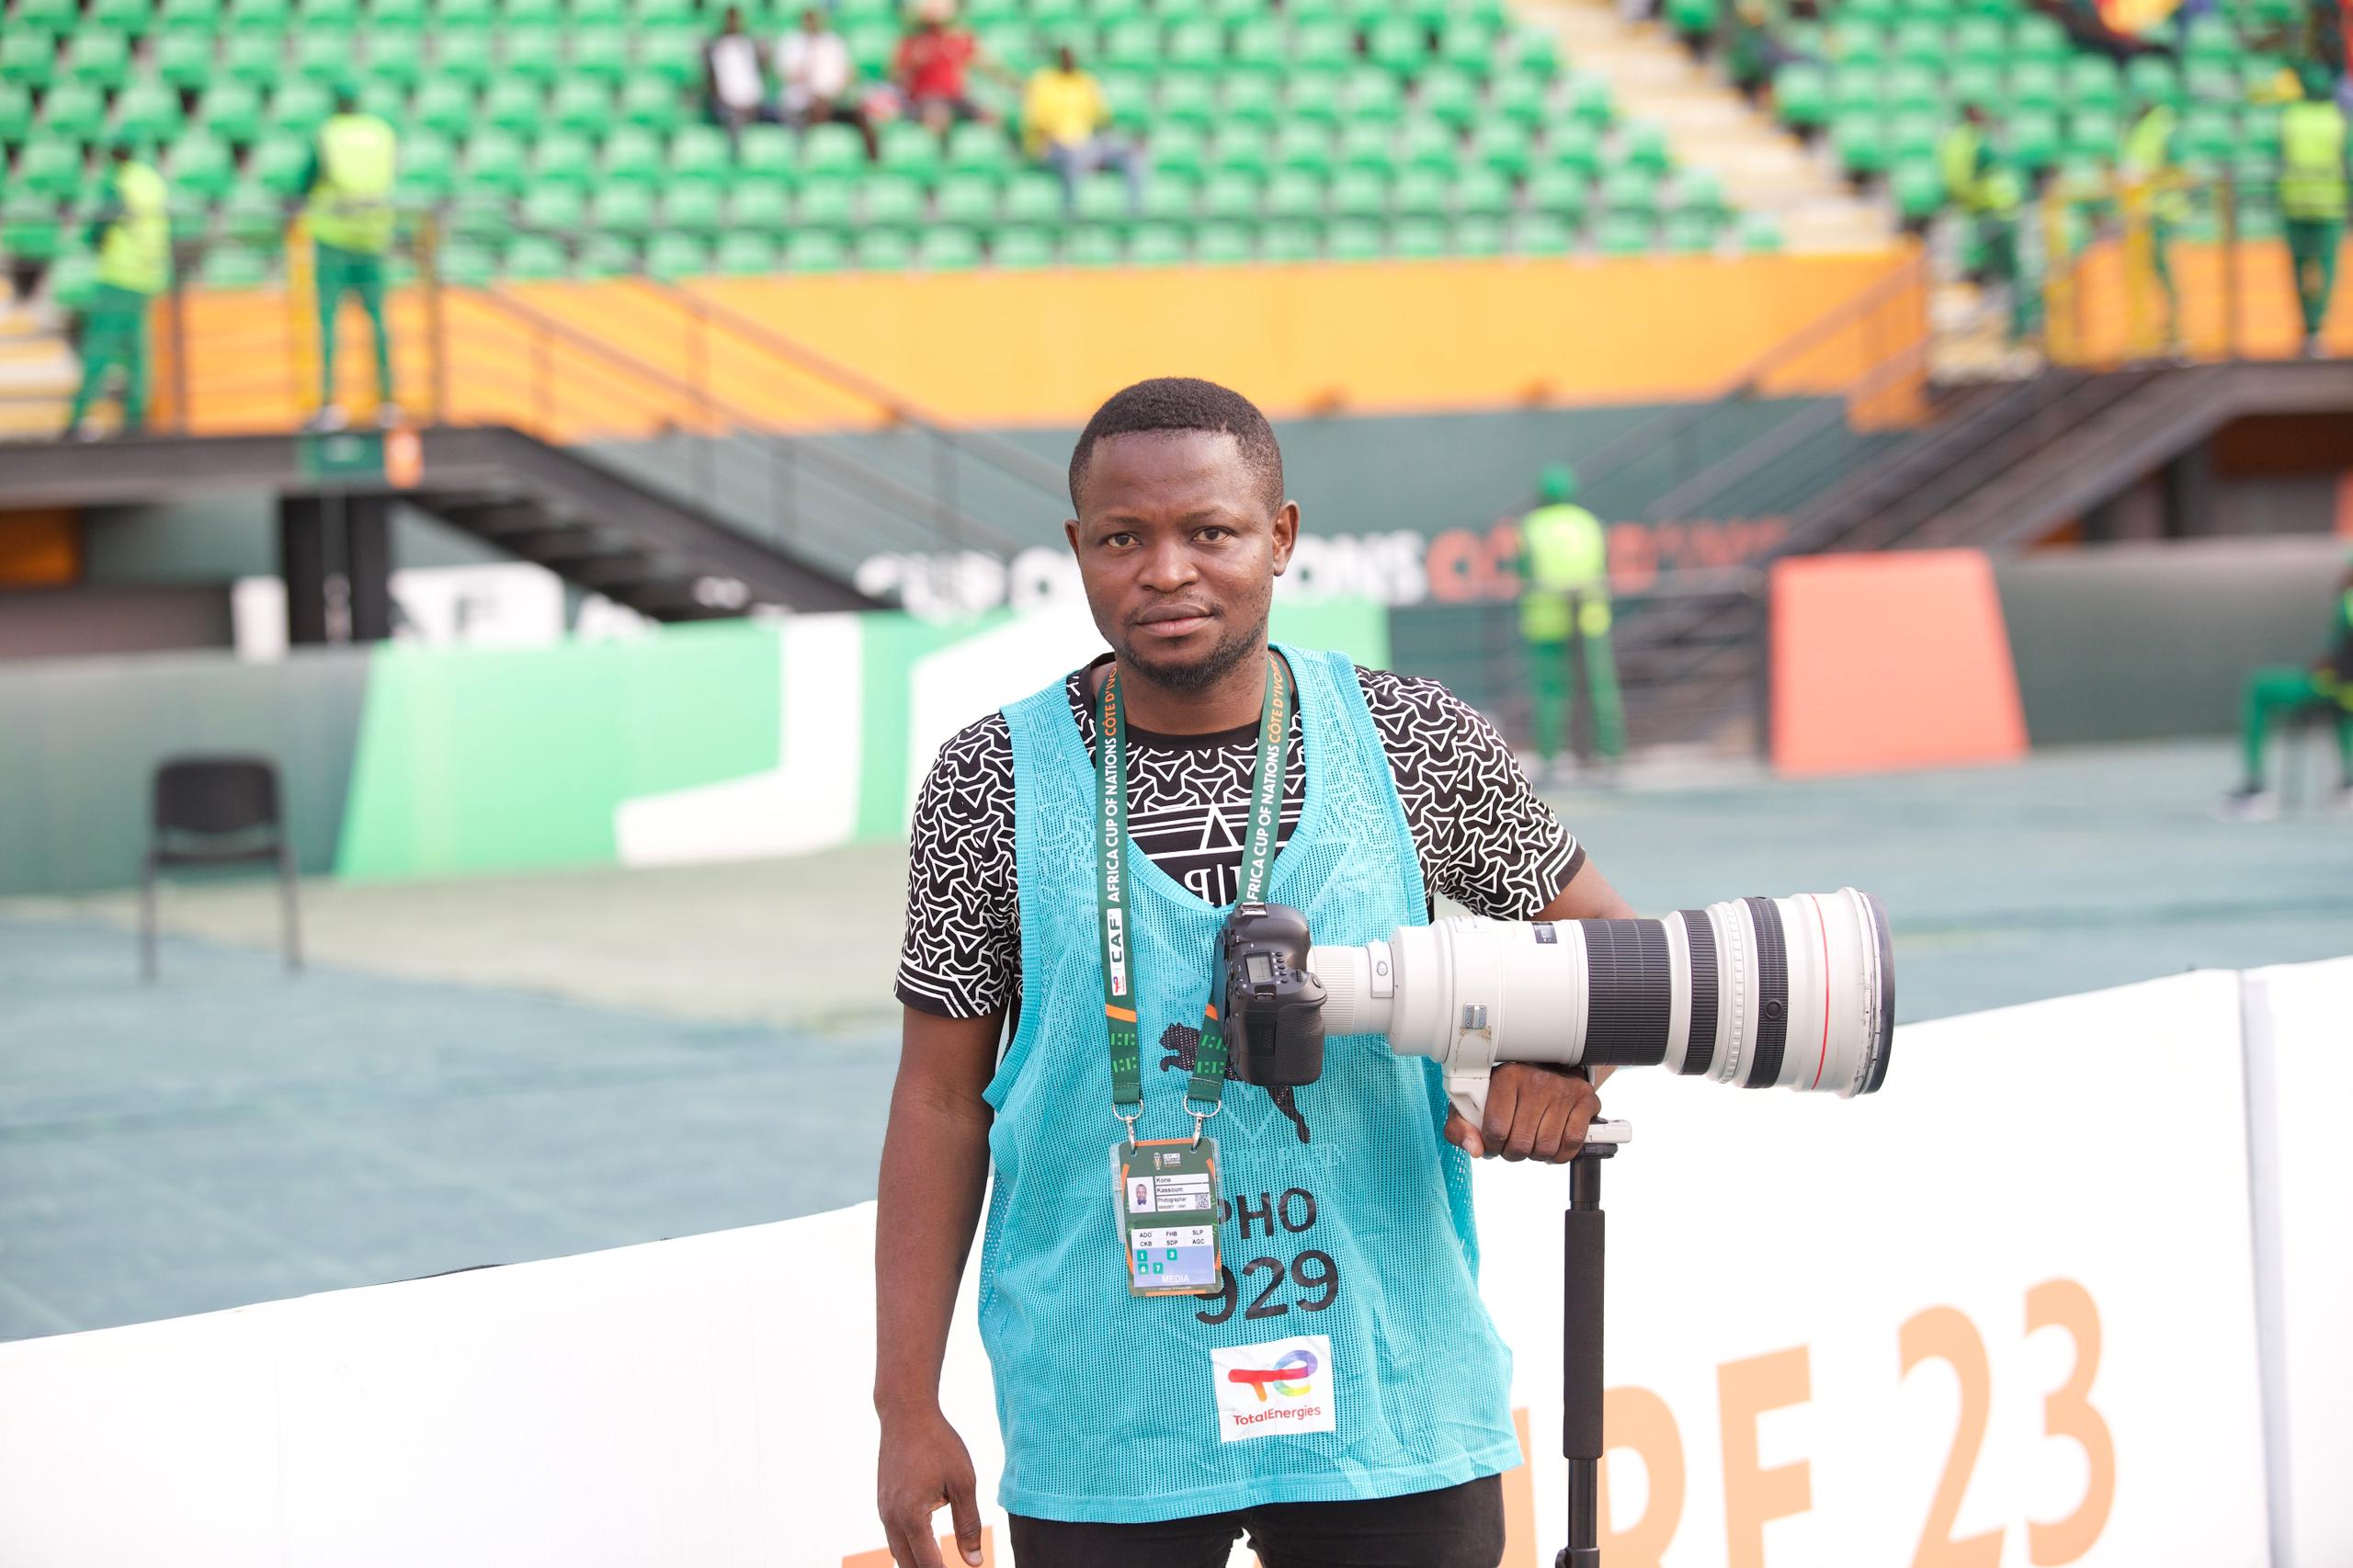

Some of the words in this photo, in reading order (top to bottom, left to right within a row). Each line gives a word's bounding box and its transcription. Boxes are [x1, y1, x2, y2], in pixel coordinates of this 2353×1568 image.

[1103, 703, 1117, 736] CÔTE
[1267, 710, 1283, 744] CÔTE
[1105, 737, 1118, 795] NATIONS
[1261, 744, 1279, 805] NATIONS
[1105, 798, 1118, 816] OF
[1258, 806, 1272, 825] OF
[1106, 819, 1119, 847] CUP
[1253, 827, 1268, 857] CUP
[1107, 848, 1120, 903] AFRICA
[1245, 858, 1265, 903] FRICA
[1109, 918, 1122, 963] CAF
[1162, 1275, 1190, 1283] MEDIA
[1233, 1405, 1321, 1426] TotalEnergies
[1896, 1276, 2118, 1568] 23
